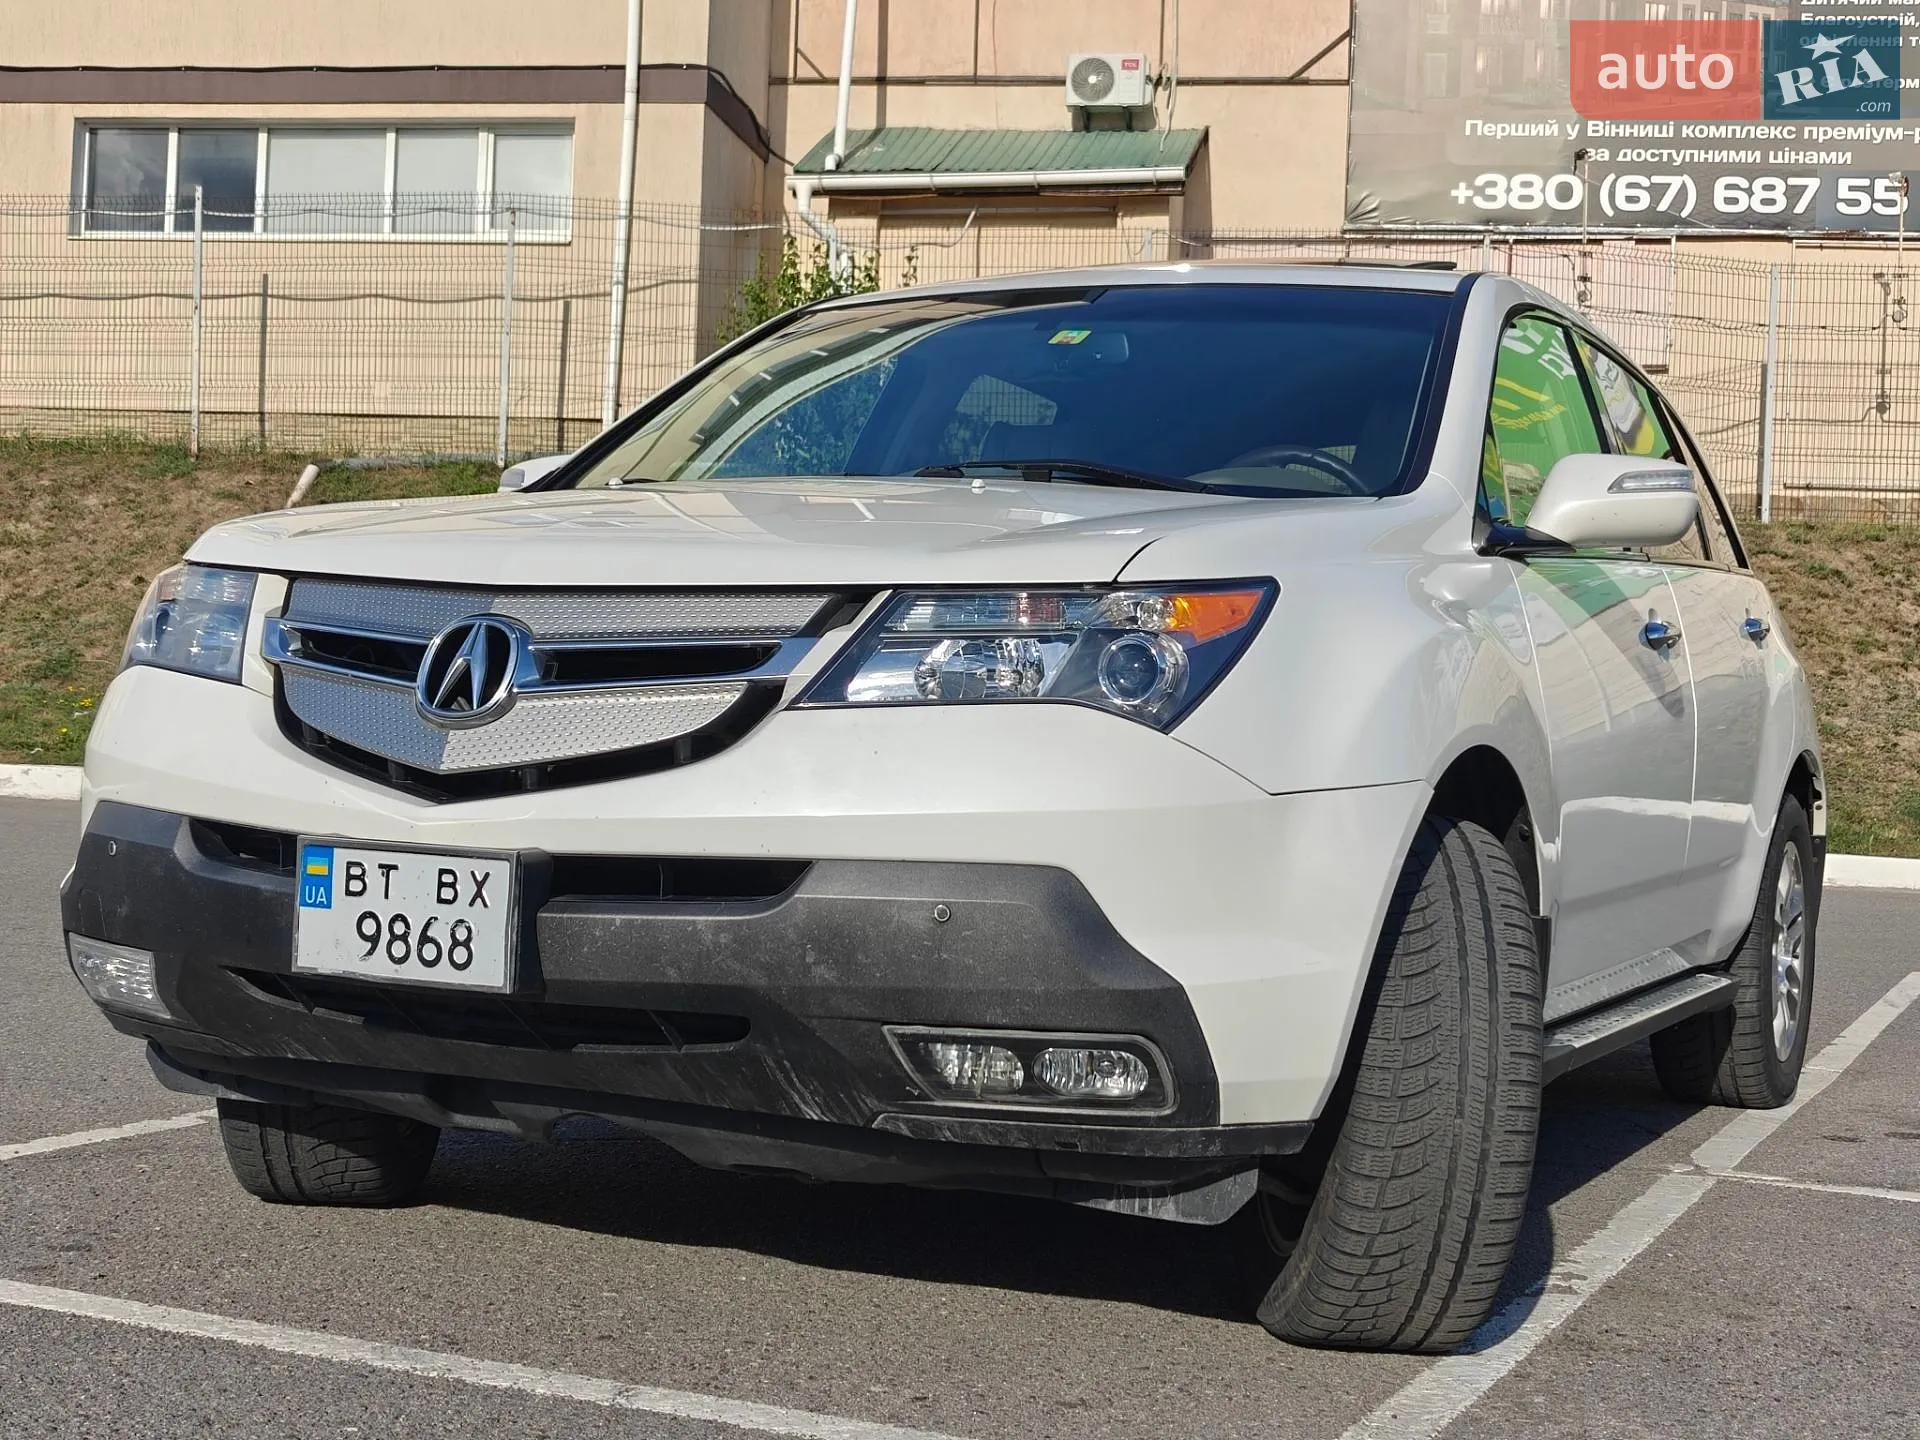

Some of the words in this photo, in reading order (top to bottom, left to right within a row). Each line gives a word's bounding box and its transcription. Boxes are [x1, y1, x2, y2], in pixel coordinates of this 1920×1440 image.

[1465, 119, 1559, 139] Перший
[1566, 124, 1580, 140] у
[1587, 120, 1674, 138] Вінниці
[1682, 124, 1796, 140] комплекс
[1586, 148, 1609, 162] за
[1616, 148, 1761, 166] доступними
[1769, 147, 1852, 165] цінами
[1450, 173, 1584, 210] +380
[1599, 172, 1697, 218] (67)
[1713, 175, 1821, 214] 687
[1835, 177, 1909, 216] 55
[305, 885, 327, 905] UA
[345, 861, 399, 900] BT
[436, 868, 491, 908] BX
[356, 911, 474, 971] 9868
